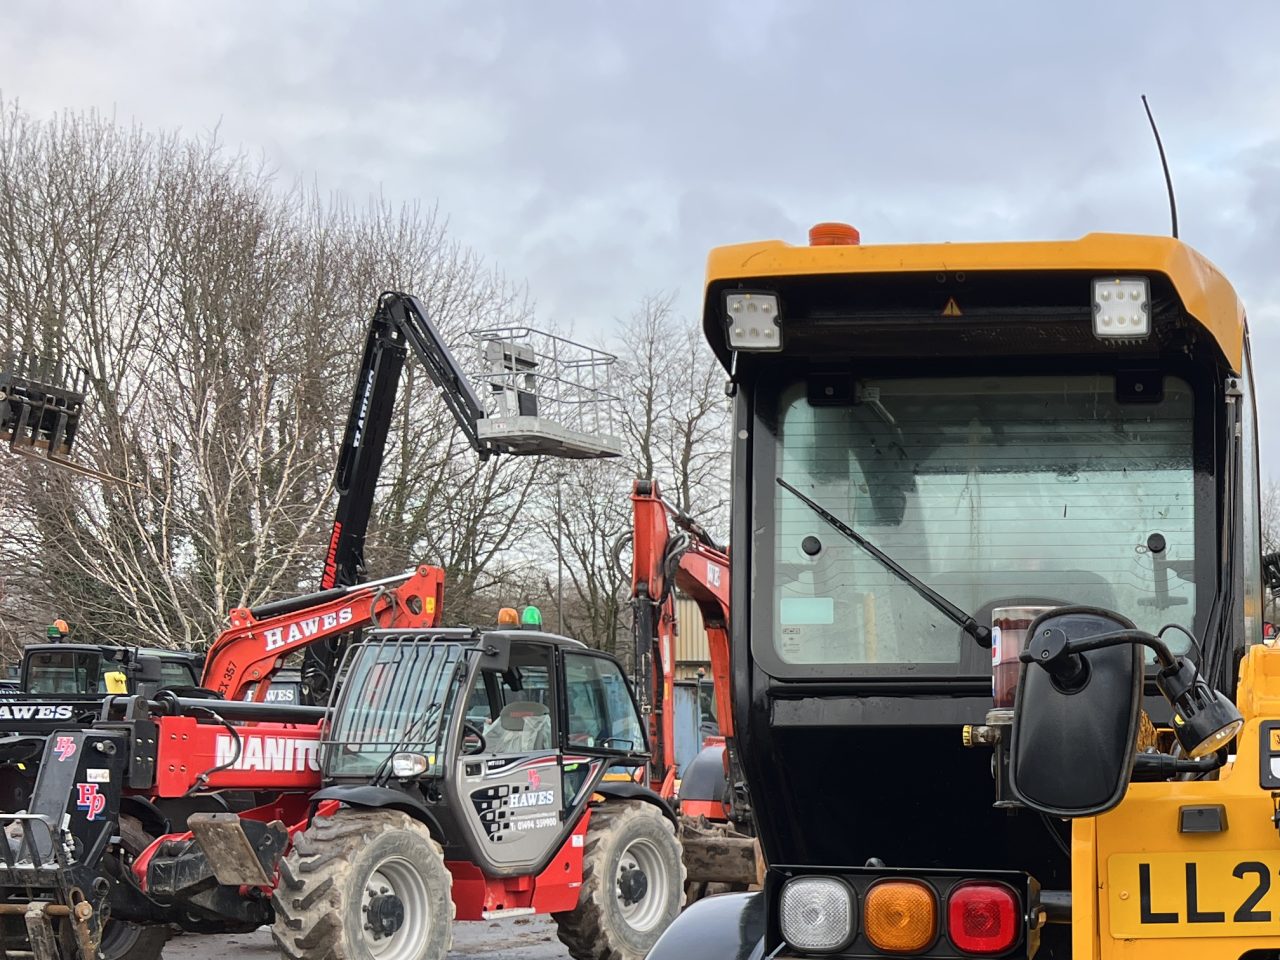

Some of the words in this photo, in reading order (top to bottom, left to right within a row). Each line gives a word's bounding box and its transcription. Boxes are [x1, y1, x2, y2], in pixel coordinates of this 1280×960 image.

[264, 607, 353, 651] HAWES
[223, 660, 237, 681] 357
[247, 689, 294, 702] HWES
[509, 790, 554, 808] HAWES
